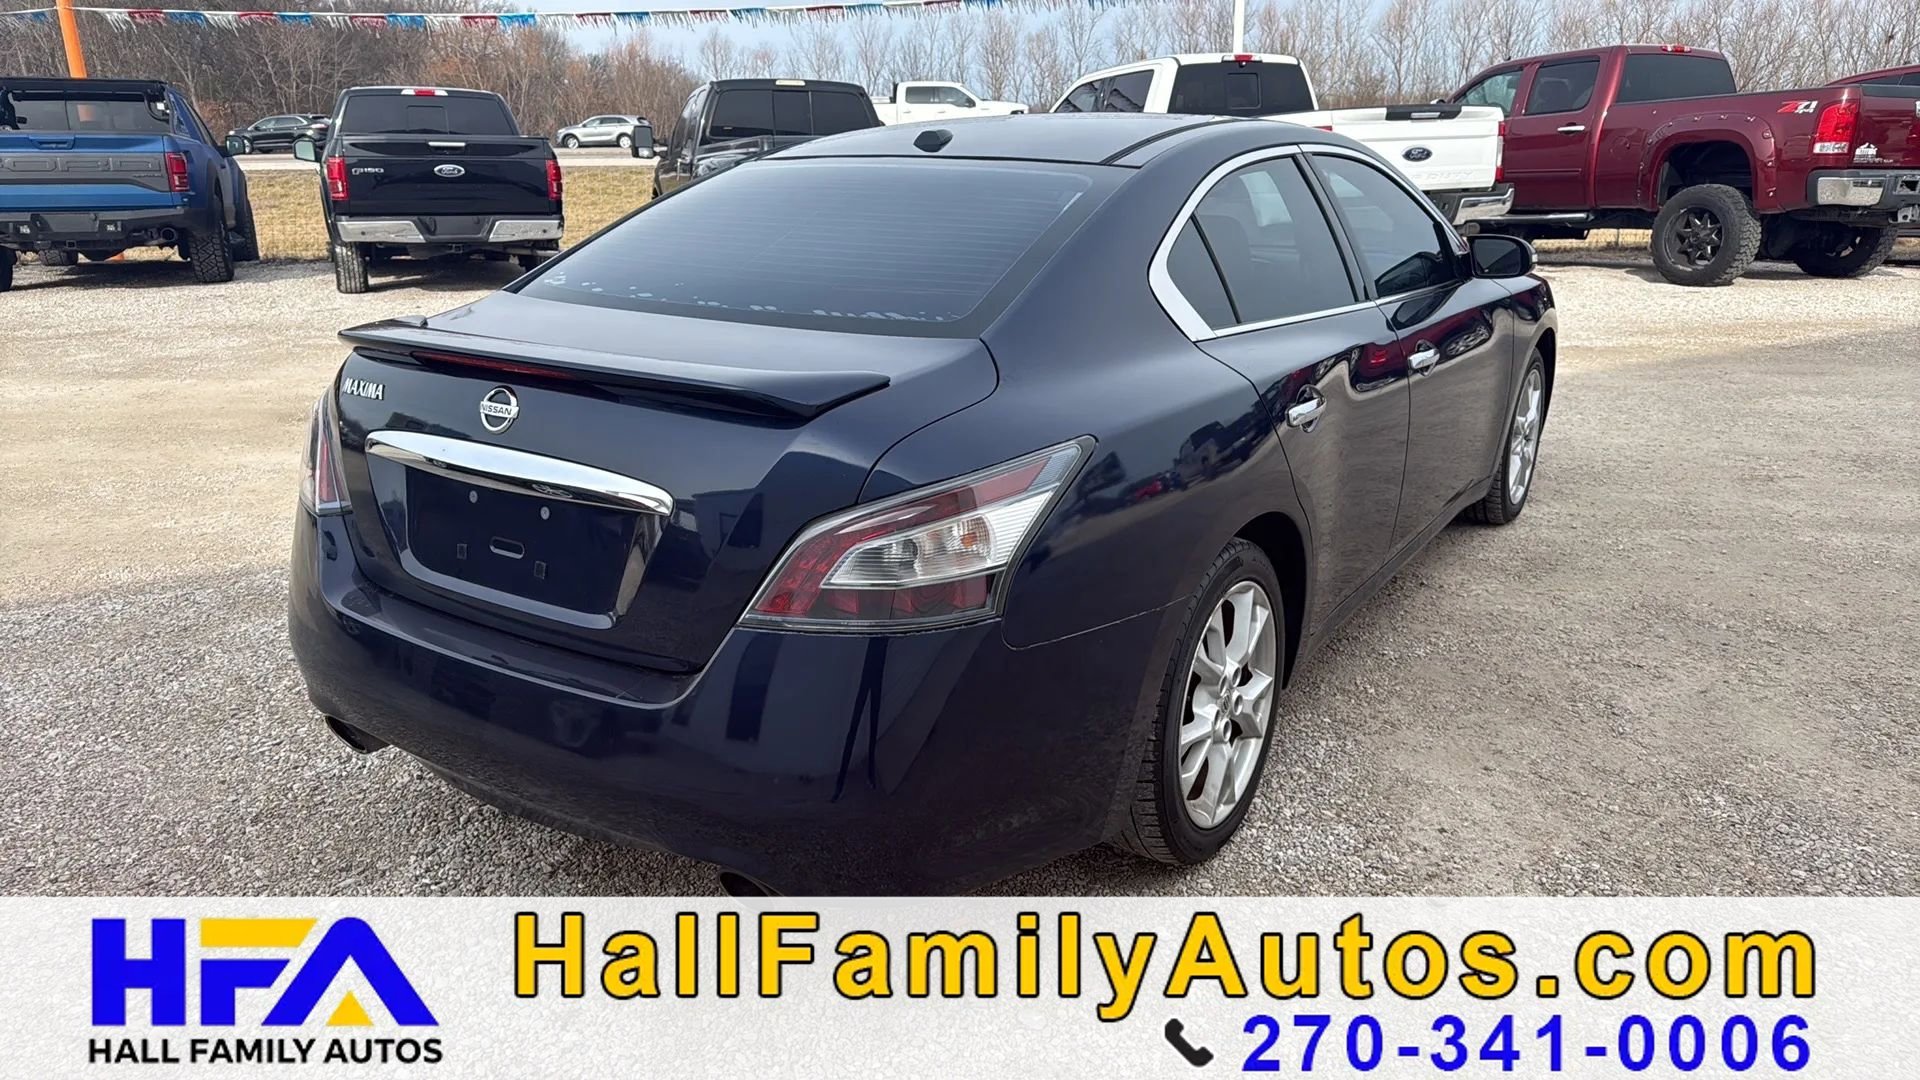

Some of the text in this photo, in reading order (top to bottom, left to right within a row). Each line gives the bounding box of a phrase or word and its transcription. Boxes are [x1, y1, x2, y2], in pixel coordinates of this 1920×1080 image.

[437, 166, 461, 176] Ford
[343, 377, 384, 400] MAXIMA
[480, 403, 512, 416] NISSAN
